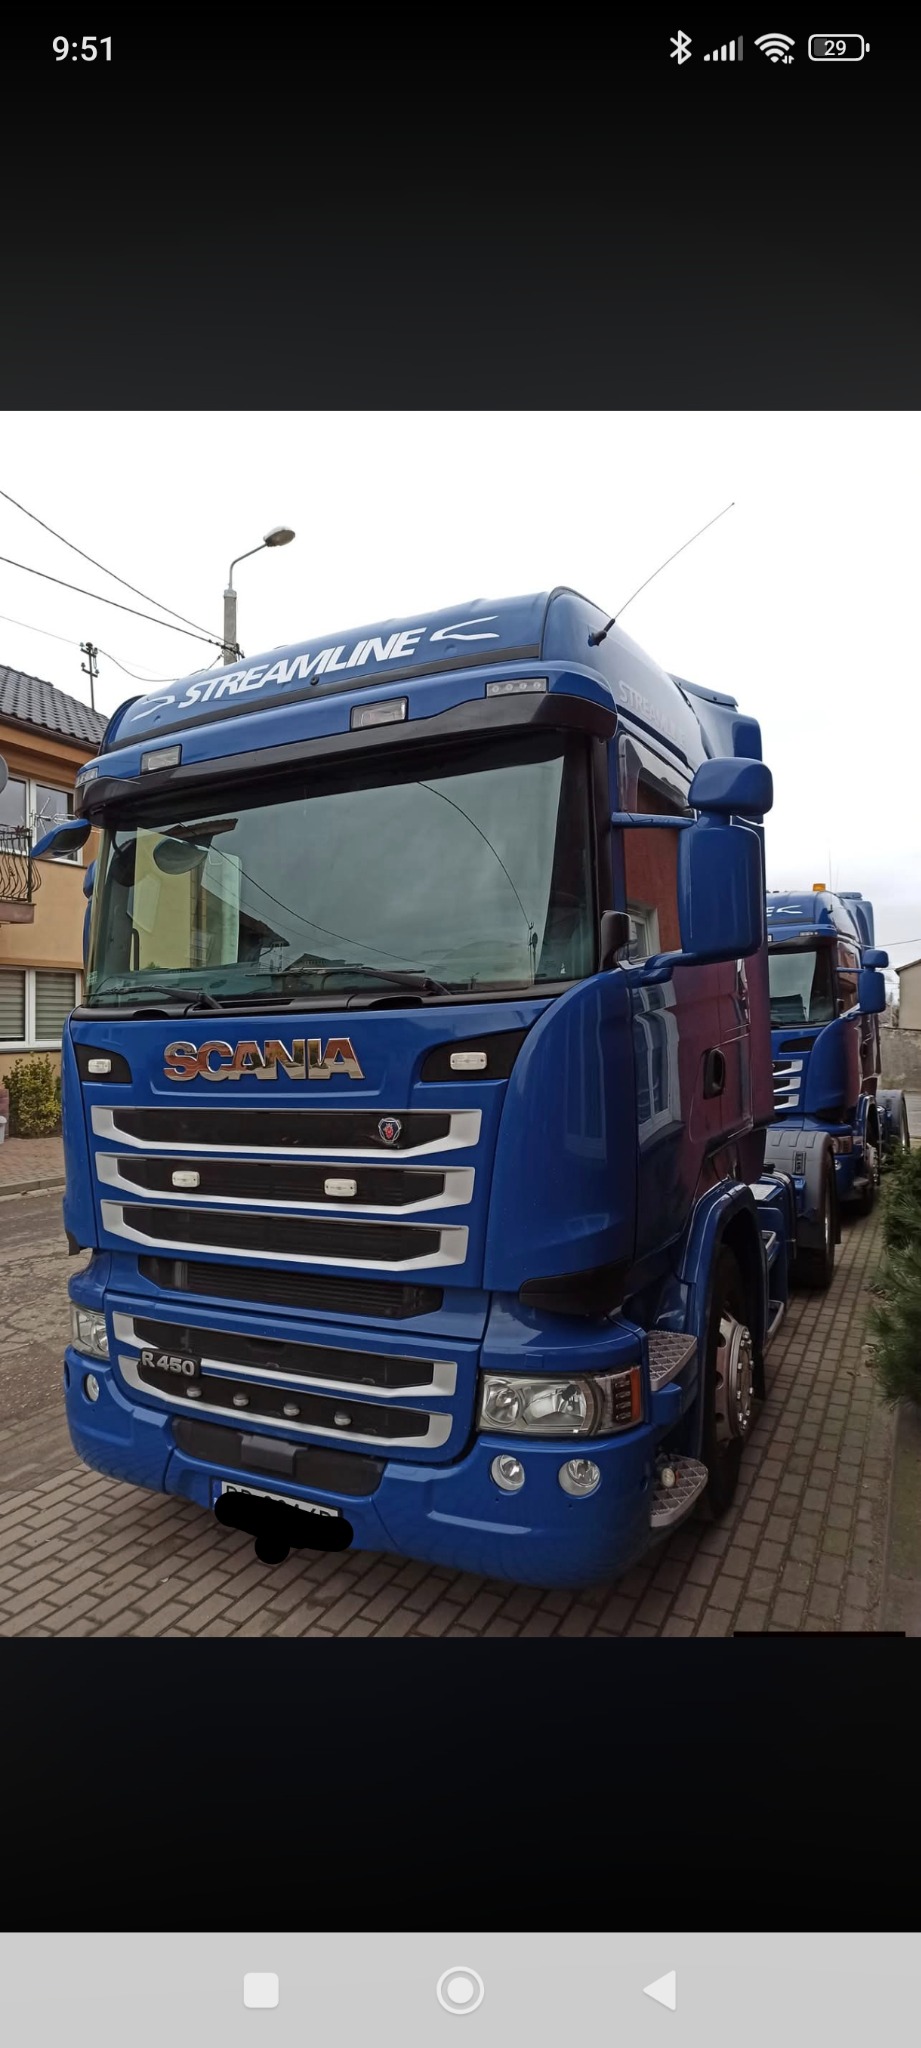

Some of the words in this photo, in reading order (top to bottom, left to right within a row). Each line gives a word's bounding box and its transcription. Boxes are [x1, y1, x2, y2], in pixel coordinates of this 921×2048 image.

[179, 628, 426, 709] STREAMLINE
[163, 1037, 365, 1081] SCANIA
[141, 1350, 155, 1368] R
[156, 1355, 195, 1377] 450
